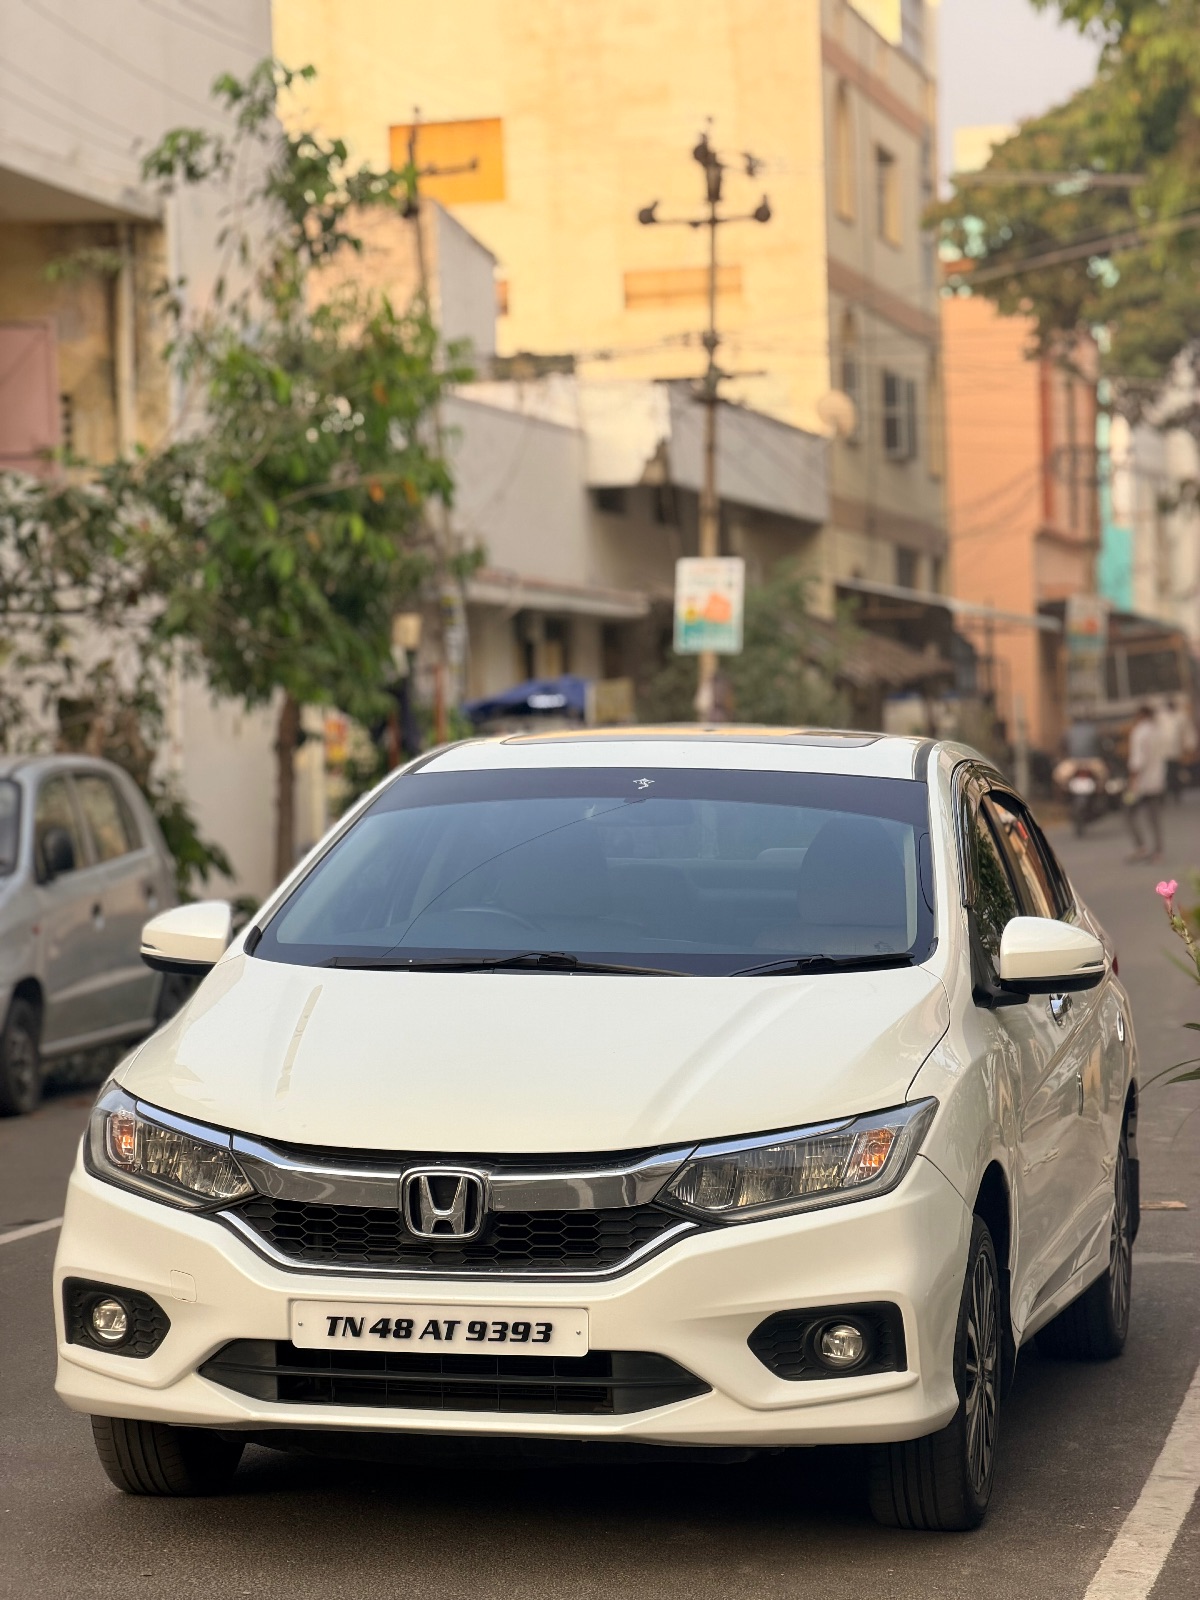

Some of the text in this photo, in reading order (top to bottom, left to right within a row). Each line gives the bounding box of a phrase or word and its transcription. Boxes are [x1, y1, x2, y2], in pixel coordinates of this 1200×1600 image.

[326, 1316, 553, 1343] TN 48 AT 9393
